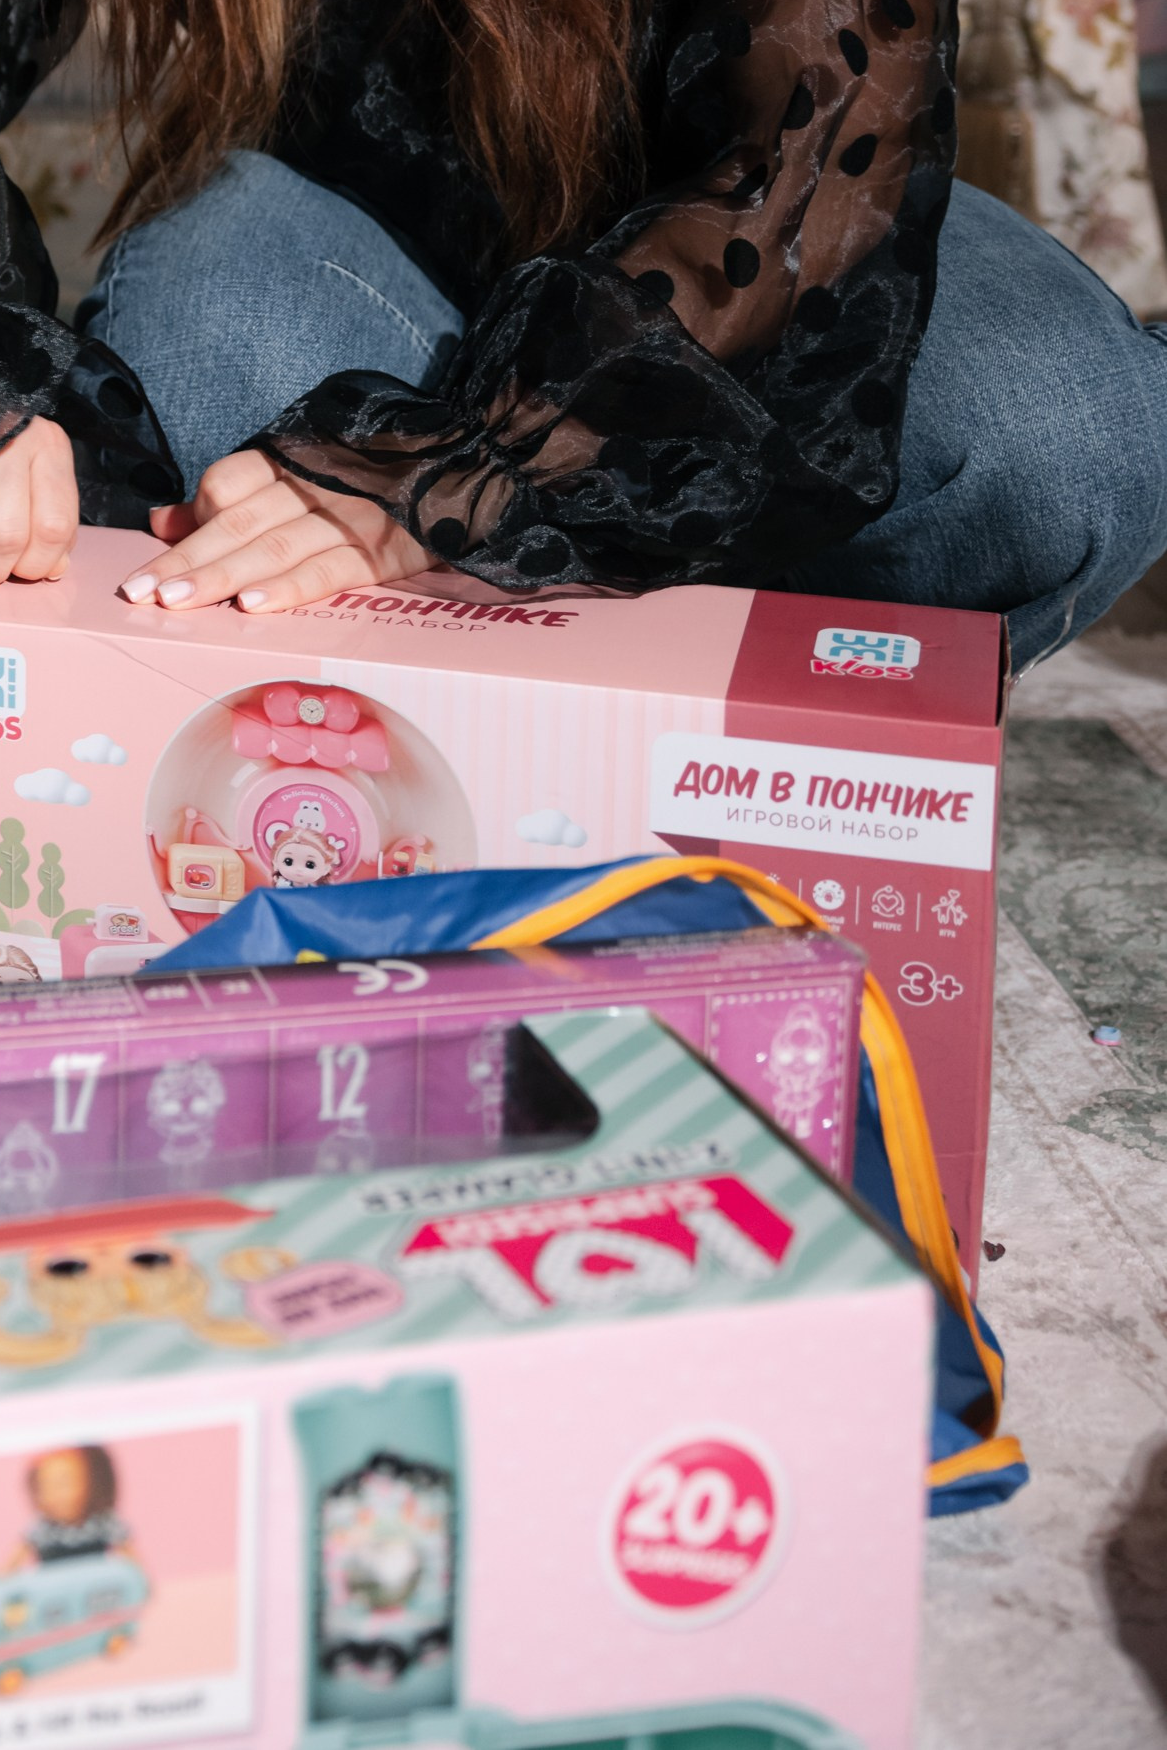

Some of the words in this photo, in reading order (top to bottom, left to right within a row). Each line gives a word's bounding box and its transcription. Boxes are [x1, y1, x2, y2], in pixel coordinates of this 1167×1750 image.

[328, 592, 580, 628] ПОНЧИКЕ
[373, 616, 488, 632] НАБОР
[673, 760, 760, 799] ДОМ
[770, 771, 795, 803] В
[806, 774, 974, 823] ПОНЧИКЕ
[726, 807, 832, 834] ИГРОВОЙ
[841, 821, 919, 842] НАБОР
[872, 920, 902, 933] ИНТЕРЕС
[938, 928, 957, 939] ИГРА
[897, 961, 964, 1007] 3+
[47, 1053, 107, 1135] 17
[316, 1043, 370, 1121] 12
[625, 1463, 771, 1548] 20+
